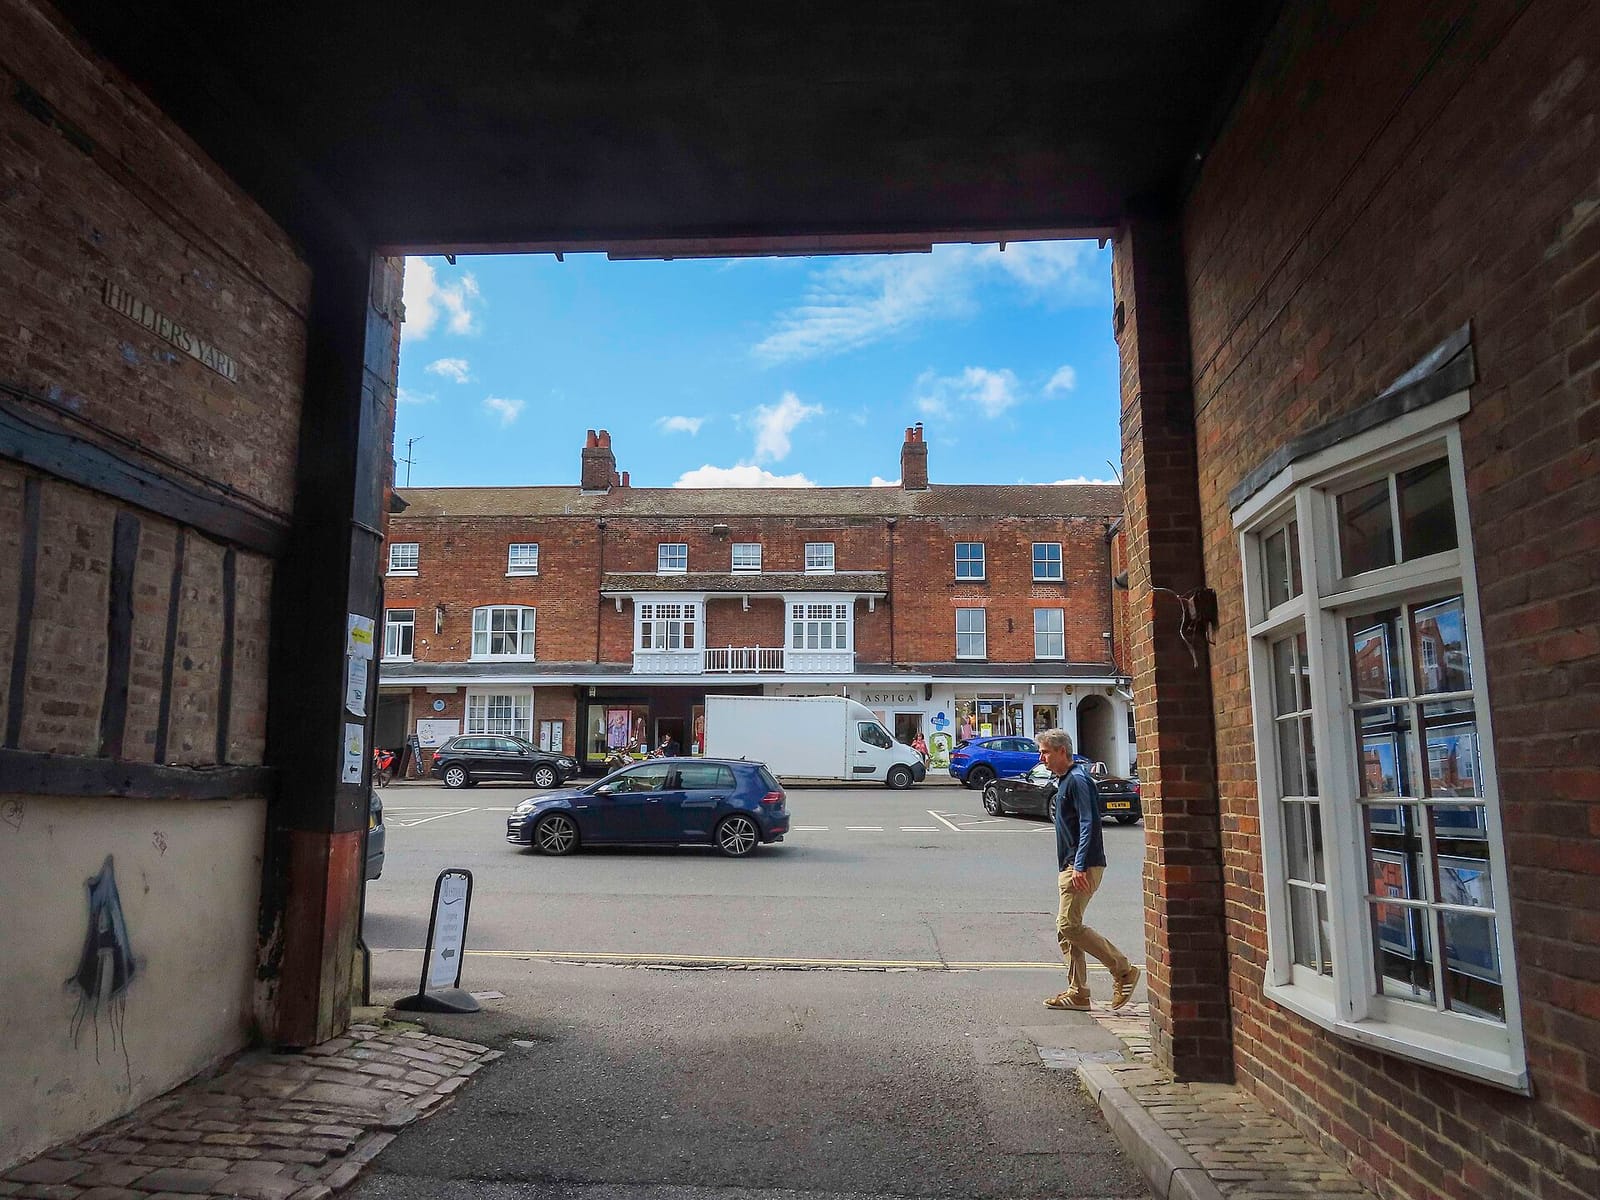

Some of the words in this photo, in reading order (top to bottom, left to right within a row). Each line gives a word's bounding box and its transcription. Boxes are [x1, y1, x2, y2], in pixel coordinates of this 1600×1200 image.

[107, 282, 192, 352] HILLIERS
[198, 338, 237, 380] YARD
[864, 694, 914, 703] ASPIGA
